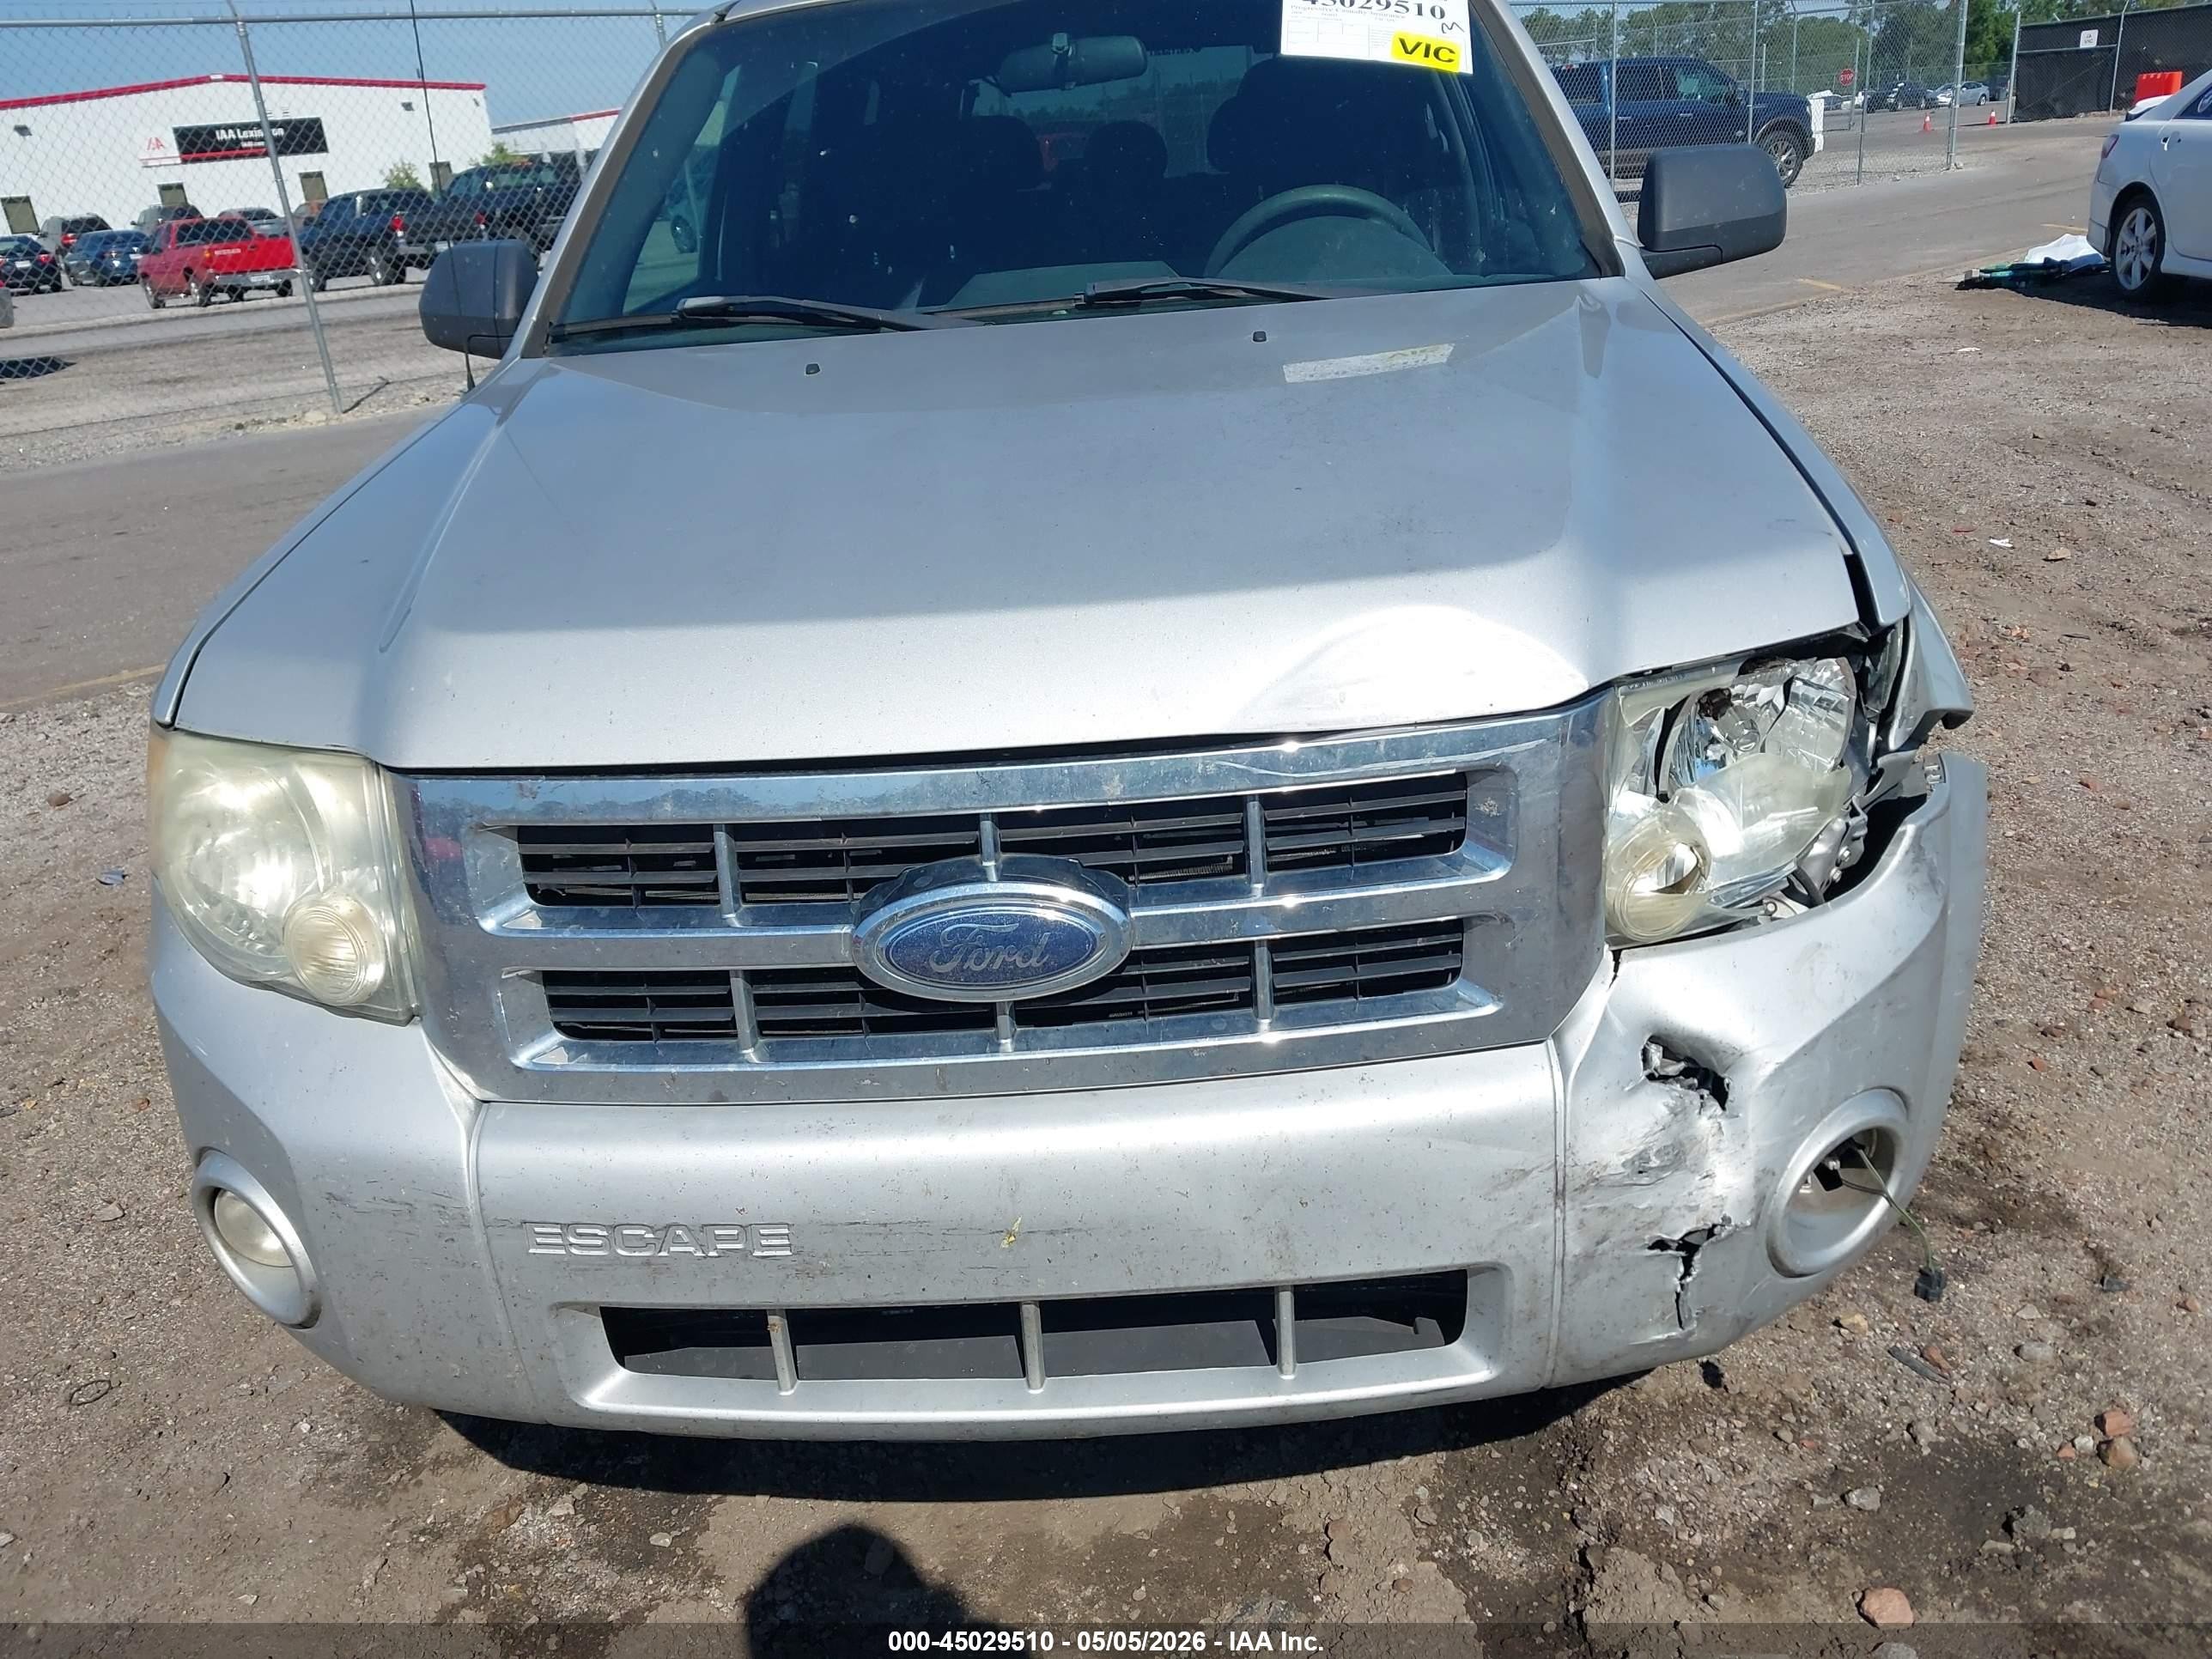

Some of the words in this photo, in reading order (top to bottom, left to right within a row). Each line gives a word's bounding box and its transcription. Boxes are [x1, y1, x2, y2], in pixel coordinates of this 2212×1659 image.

[1398, 37, 1456, 63] VIC
[215, 129, 236, 141] IAA
[236, 126, 285, 138] Lexinon
[929, 922, 1050, 973] Ford
[522, 1221, 794, 1257] ESCAPE
